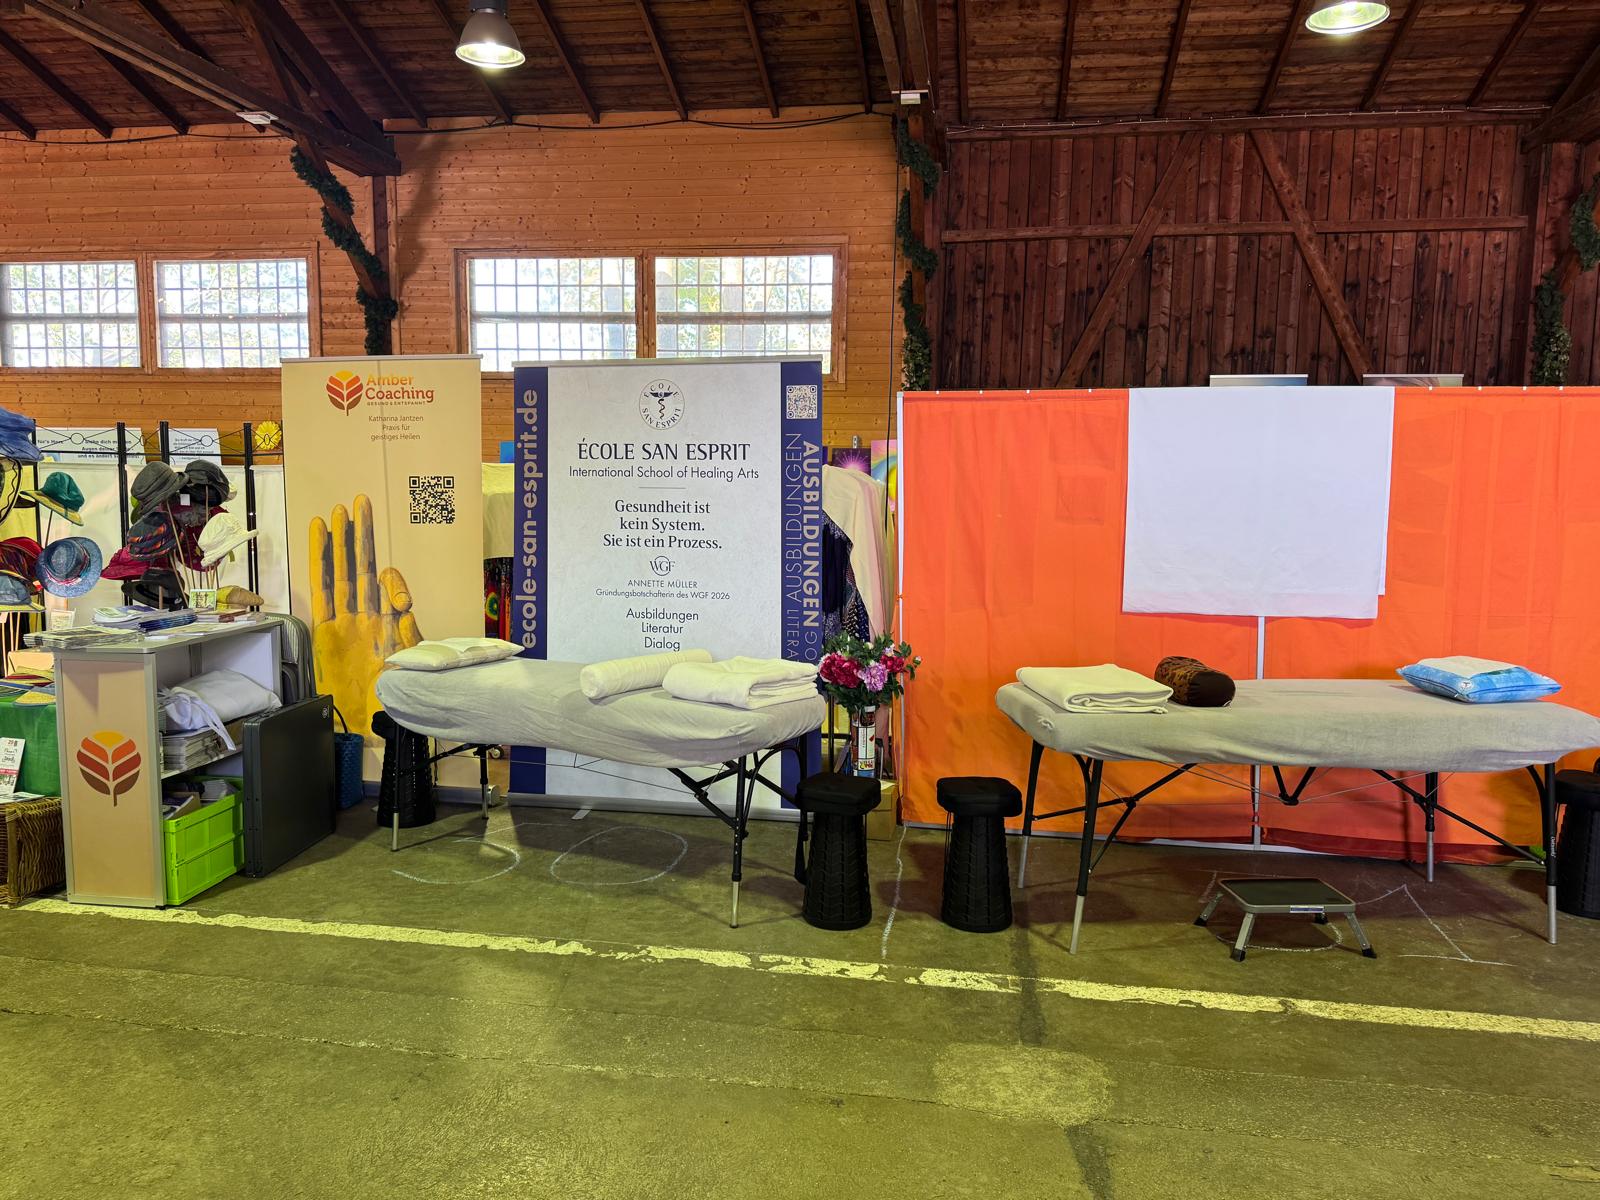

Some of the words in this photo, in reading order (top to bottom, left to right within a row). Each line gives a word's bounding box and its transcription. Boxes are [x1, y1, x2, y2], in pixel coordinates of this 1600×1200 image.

[366, 374, 414, 386] Amber
[365, 386, 435, 403] Coaching
[371, 433, 399, 442] geistiges
[400, 432, 421, 440] Heilen
[577, 438, 635, 460] ÉCOLE
[641, 443, 679, 461] SAN
[686, 443, 751, 461] ESPRIT
[569, 465, 634, 477] International
[637, 466, 673, 478] School
[676, 466, 688, 478] of
[691, 466, 734, 482] Healing
[737, 467, 760, 479] Arts
[615, 499, 692, 513] Gesundheit
[694, 501, 711, 514] ist
[516, 389, 543, 649] ecole-san-esprit.de
[620, 517, 649, 530] kein
[652, 517, 705, 533] System.
[785, 433, 802, 602] AUSBILDUNGEN
[603, 533, 623, 547] Sie
[626, 534, 642, 547] ist
[644, 535, 665, 548] ein
[668, 535, 723, 549] Prozess.
[802, 441, 820, 627] AUSBILDUNGEN
[649, 559, 676, 573] WGF
[627, 579, 665, 588] ANNETTE
[667, 579, 698, 589] MÜLLER
[595, 588, 675, 599] Gründungsbotschafterin
[676, 590, 689, 599] des
[690, 591, 709, 600] WGF
[711, 592, 731, 600] 2026
[626, 607, 699, 623] Ausbildungen
[641, 622, 684, 634] Literatur
[786, 610, 800, 661] LITERA
[644, 637, 681, 652] Dialog
[804, 631, 818, 660] OG
